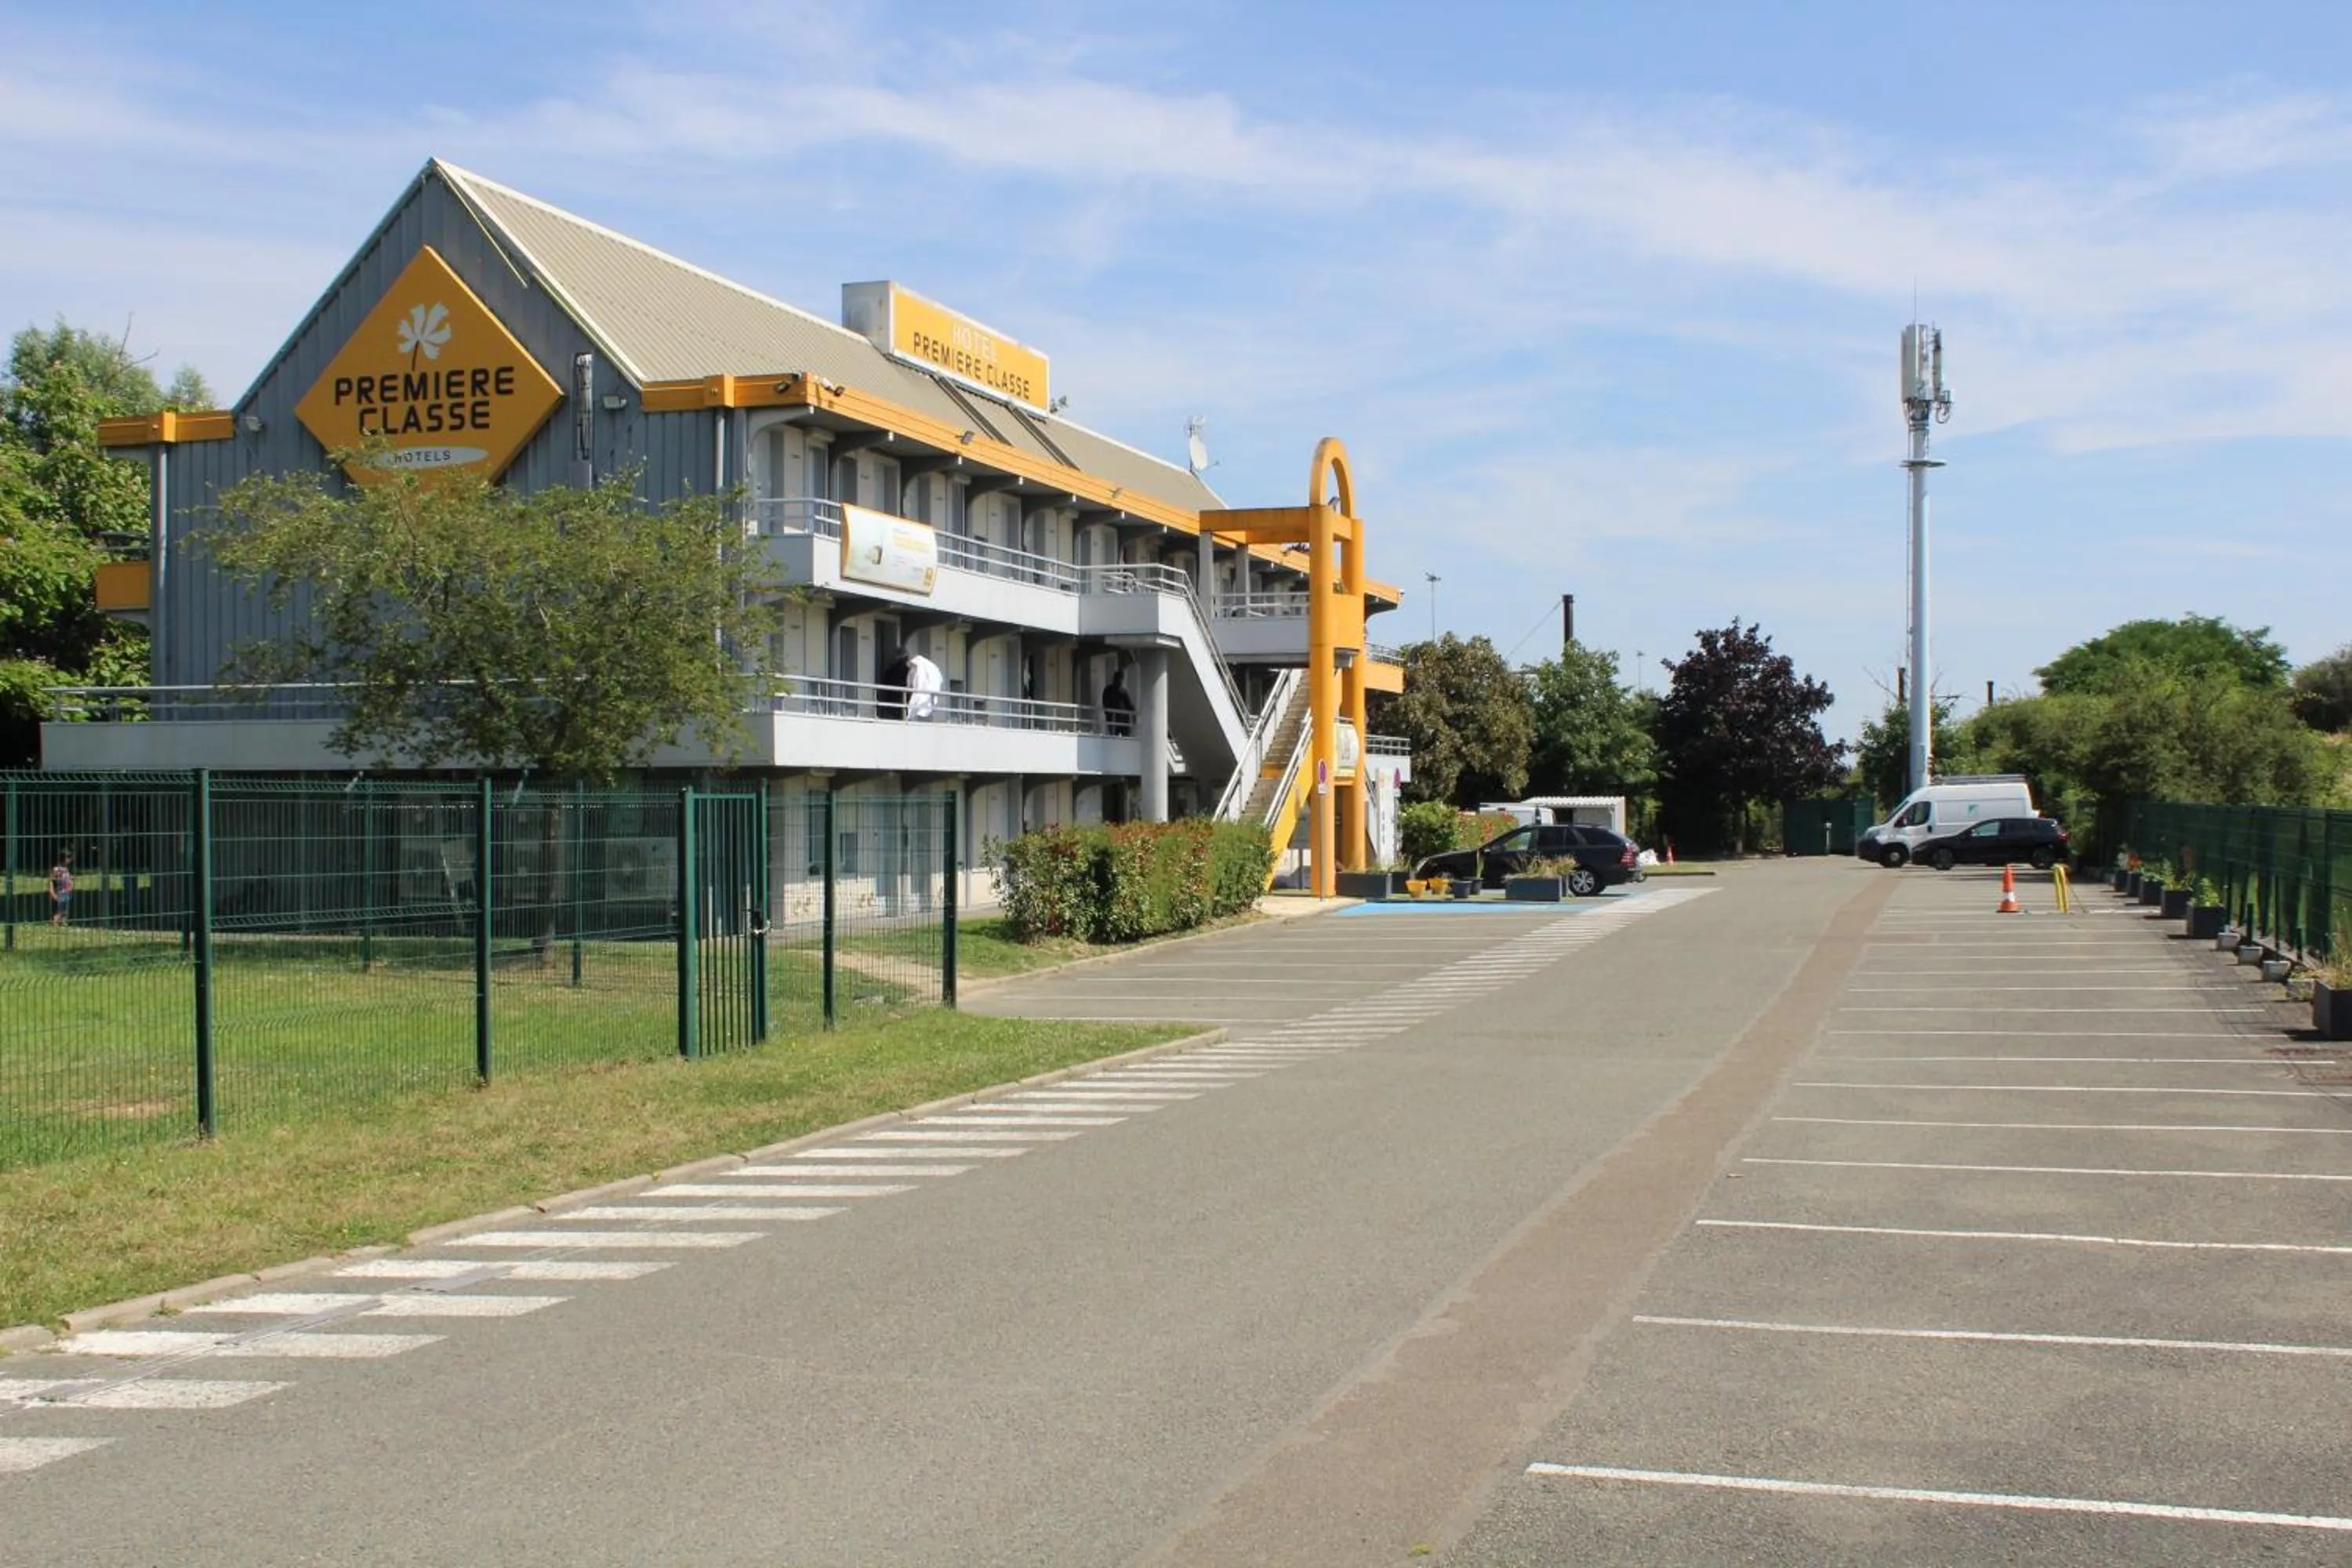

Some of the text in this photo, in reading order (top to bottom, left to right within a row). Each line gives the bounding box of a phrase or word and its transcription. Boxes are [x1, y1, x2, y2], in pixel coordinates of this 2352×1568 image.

[953, 325, 997, 363] HOTEL
[913, 332, 1029, 400] PREMIERE CLASSE
[335, 366, 514, 405] PREMIERE
[359, 401, 489, 435] CLASSE
